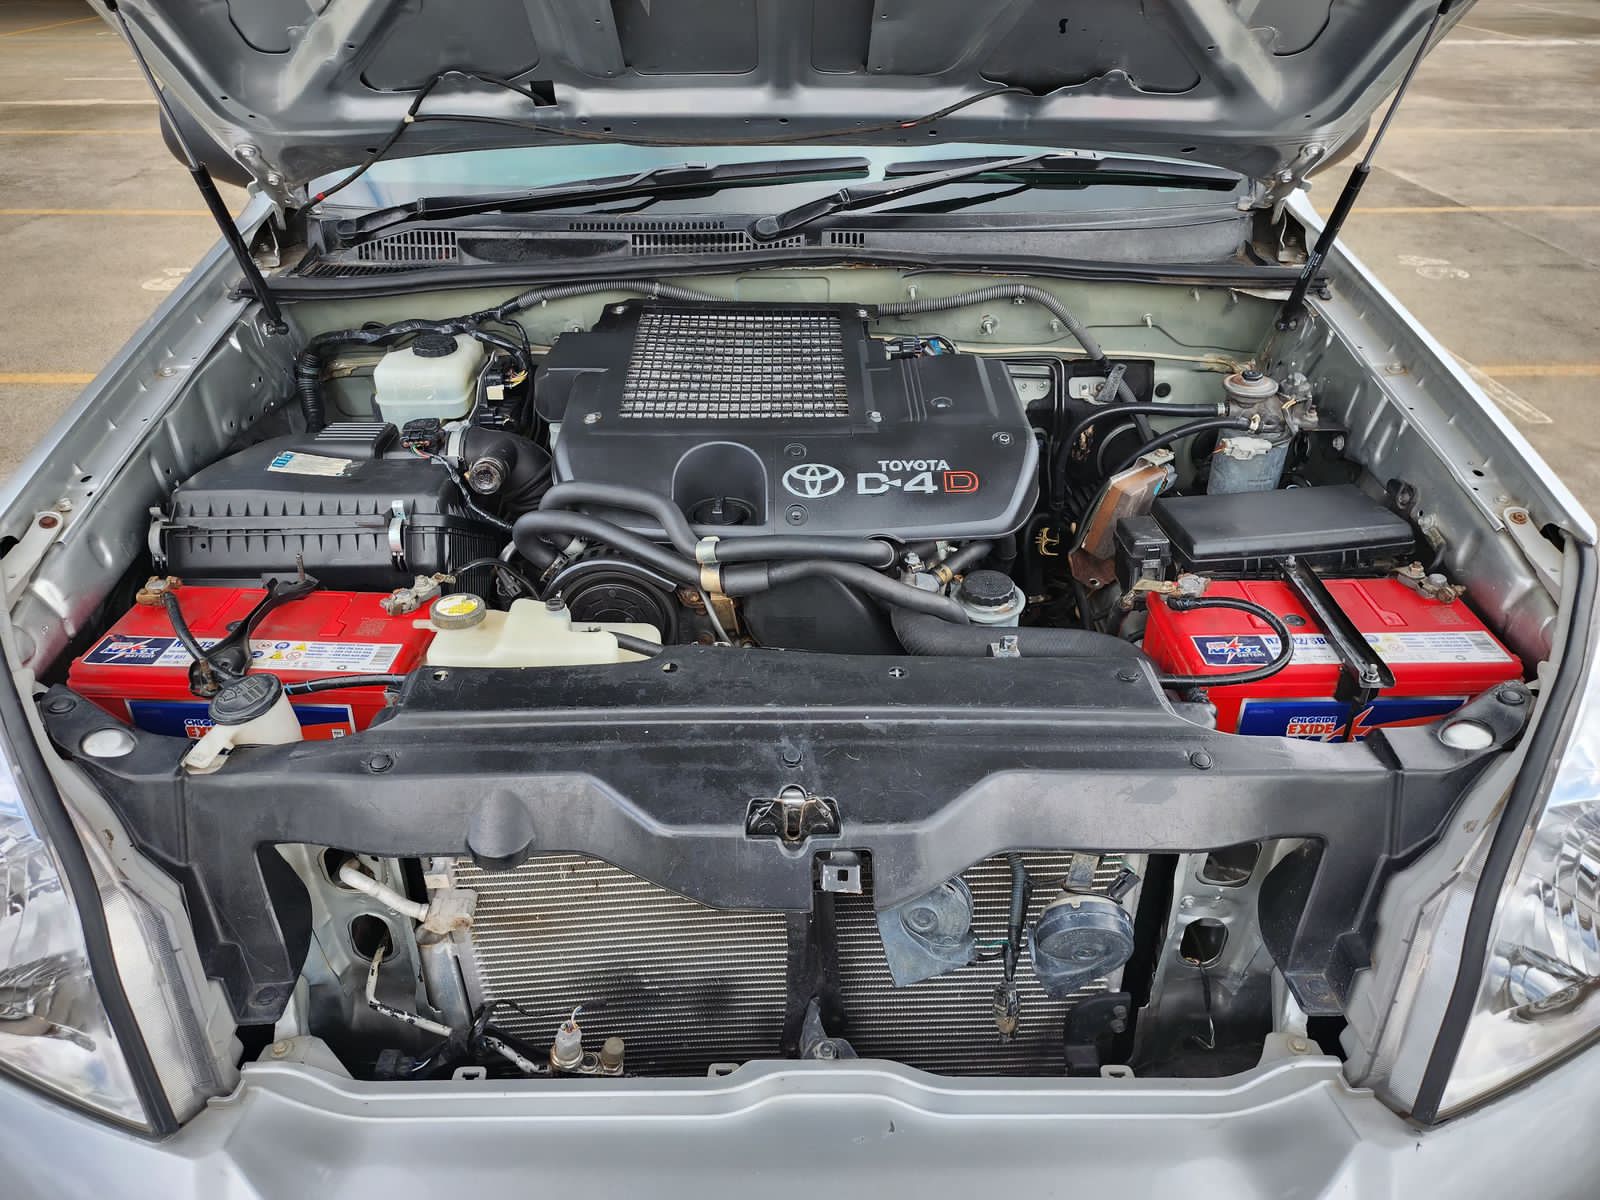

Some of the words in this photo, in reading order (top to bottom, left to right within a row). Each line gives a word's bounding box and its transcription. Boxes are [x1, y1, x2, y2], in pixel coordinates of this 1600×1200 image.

[877, 459, 951, 472] TOYOTA
[856, 470, 980, 495] D-4D
[1208, 646, 1260, 654] MAXX
[1289, 716, 1338, 724] CHLORIDE
[1286, 723, 1337, 736] EXIDE
